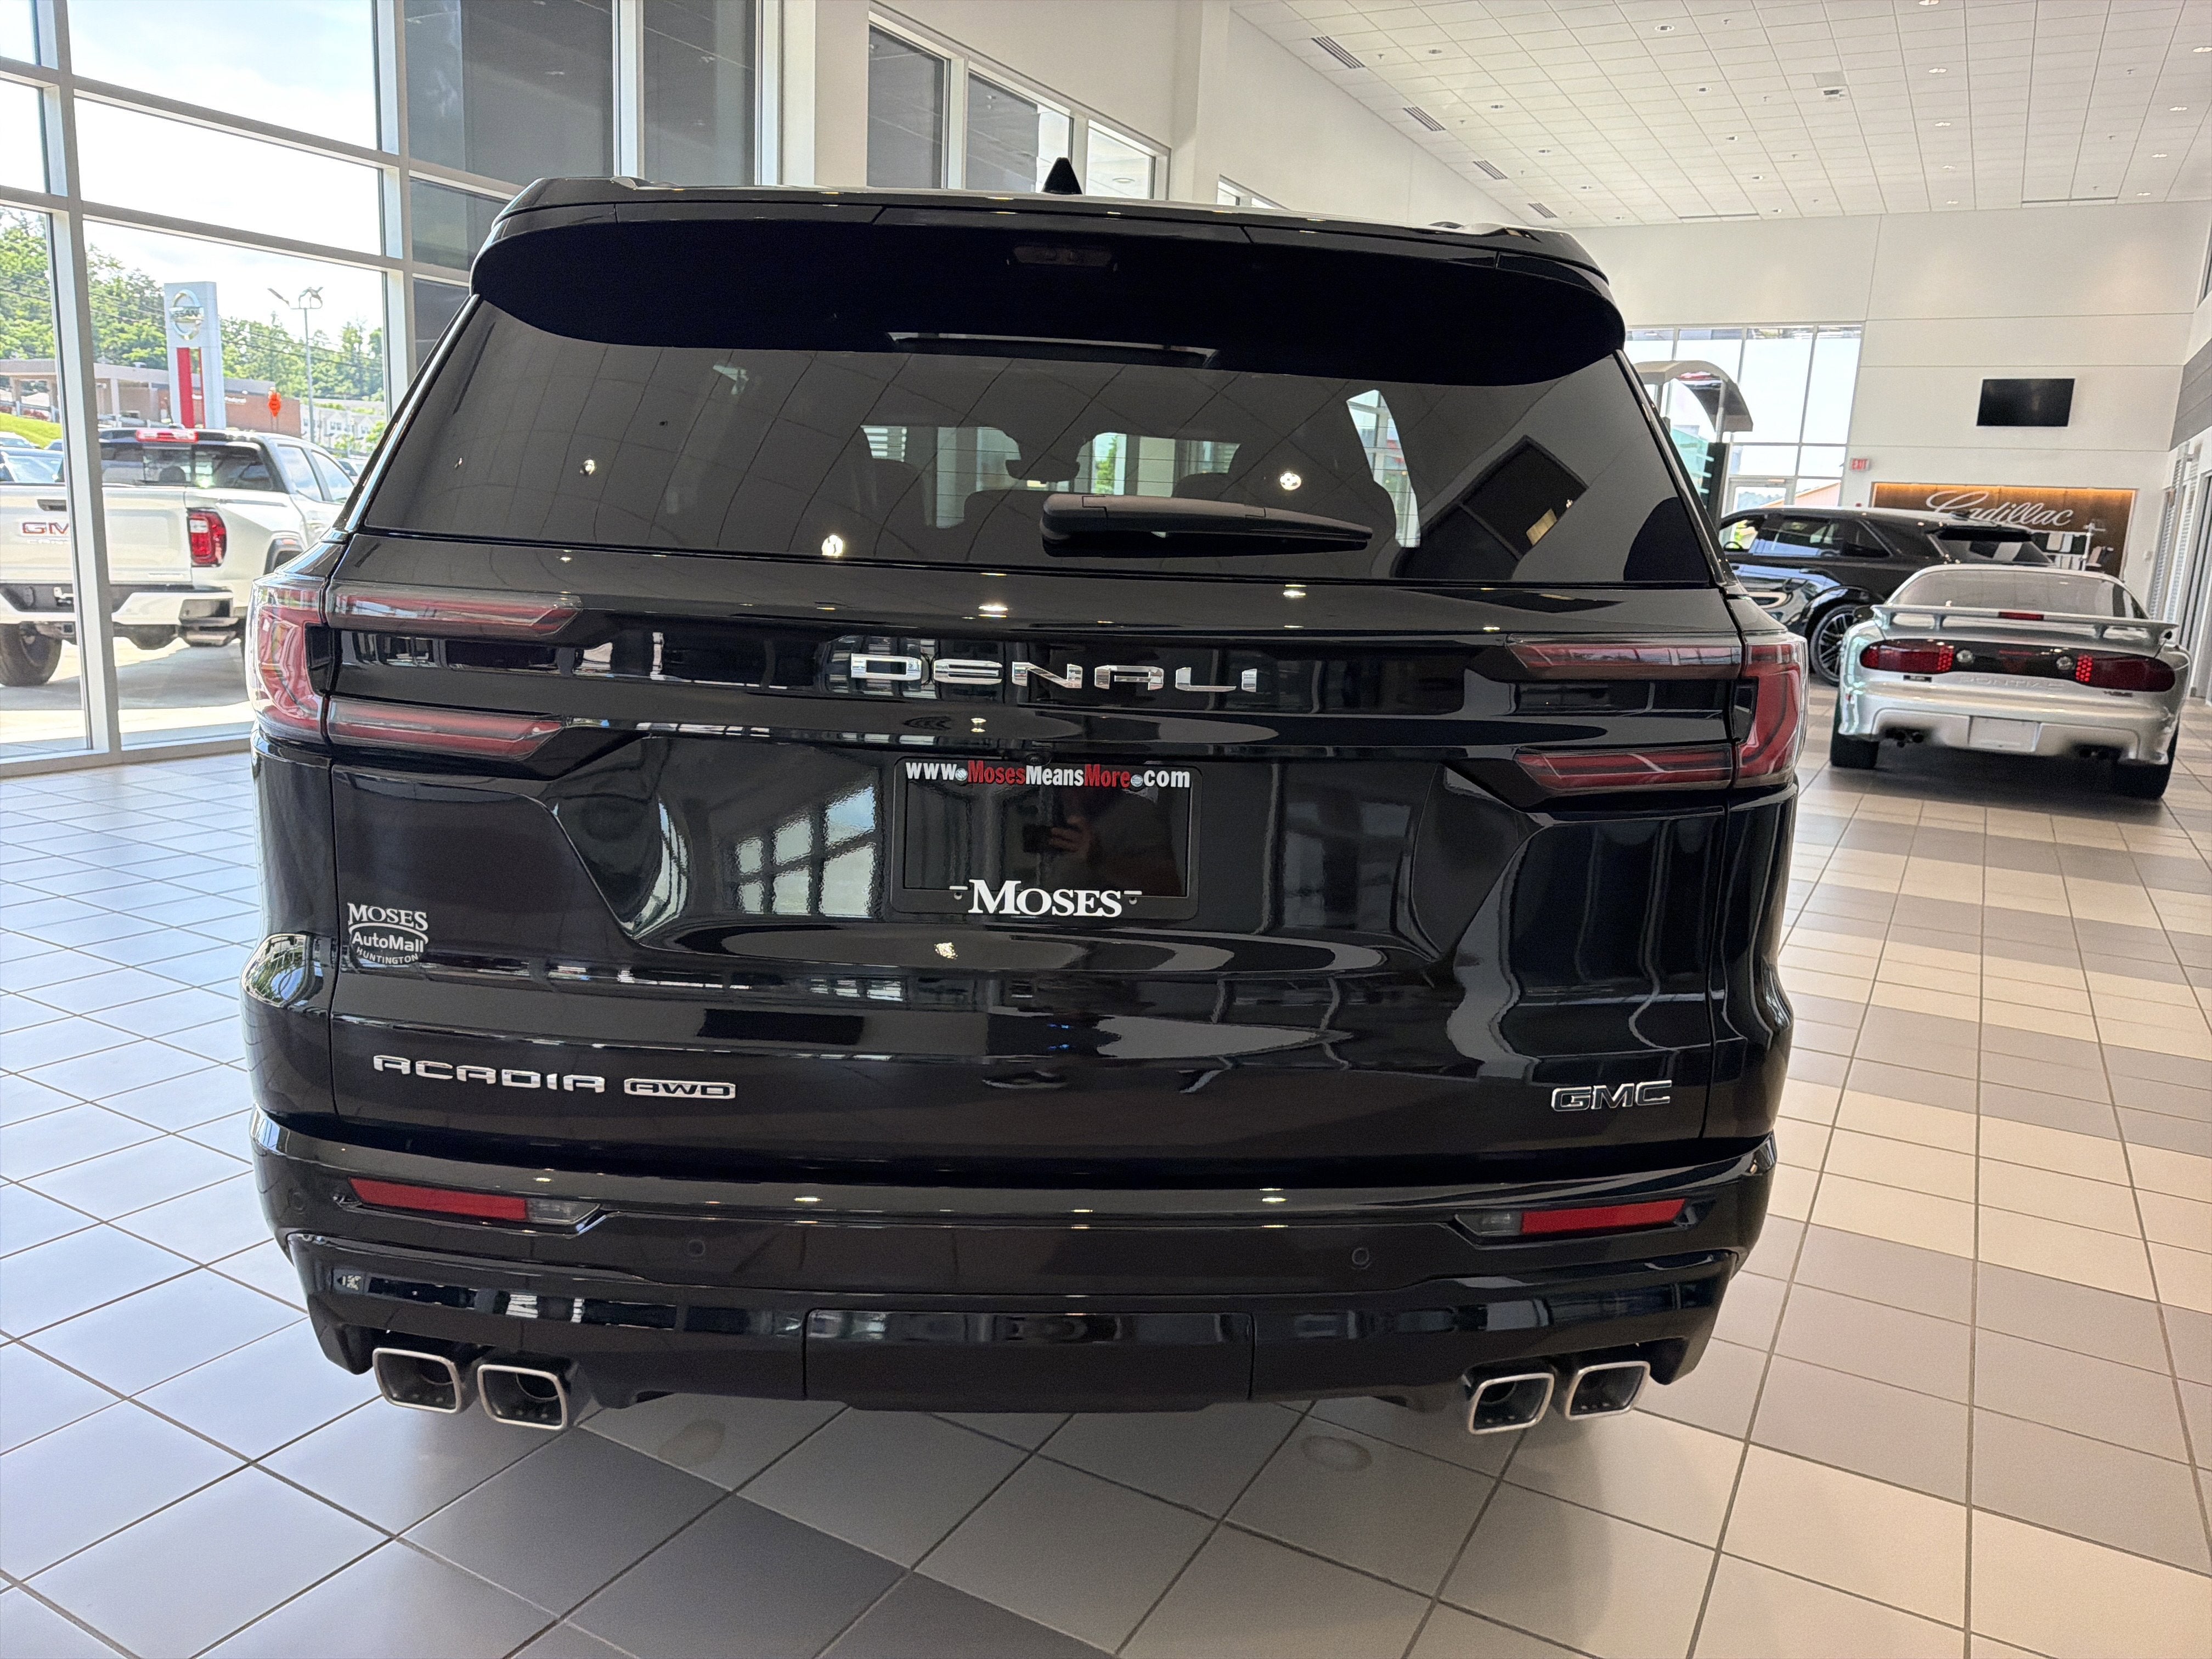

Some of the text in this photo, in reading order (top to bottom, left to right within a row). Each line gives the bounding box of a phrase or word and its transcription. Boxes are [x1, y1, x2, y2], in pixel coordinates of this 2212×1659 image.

[171, 308, 200, 318] SSAN
[22, 522, 70, 534] GM
[851, 653, 1258, 693] DENALI
[968, 879, 1122, 918] MOSES
[347, 902, 428, 931] MOSES
[352, 931, 424, 953] AutoMall
[356, 946, 419, 964] HUNTINGTON
[373, 1054, 732, 1097] ACADIA AWD
[1551, 1080, 1673, 1112] GMC
